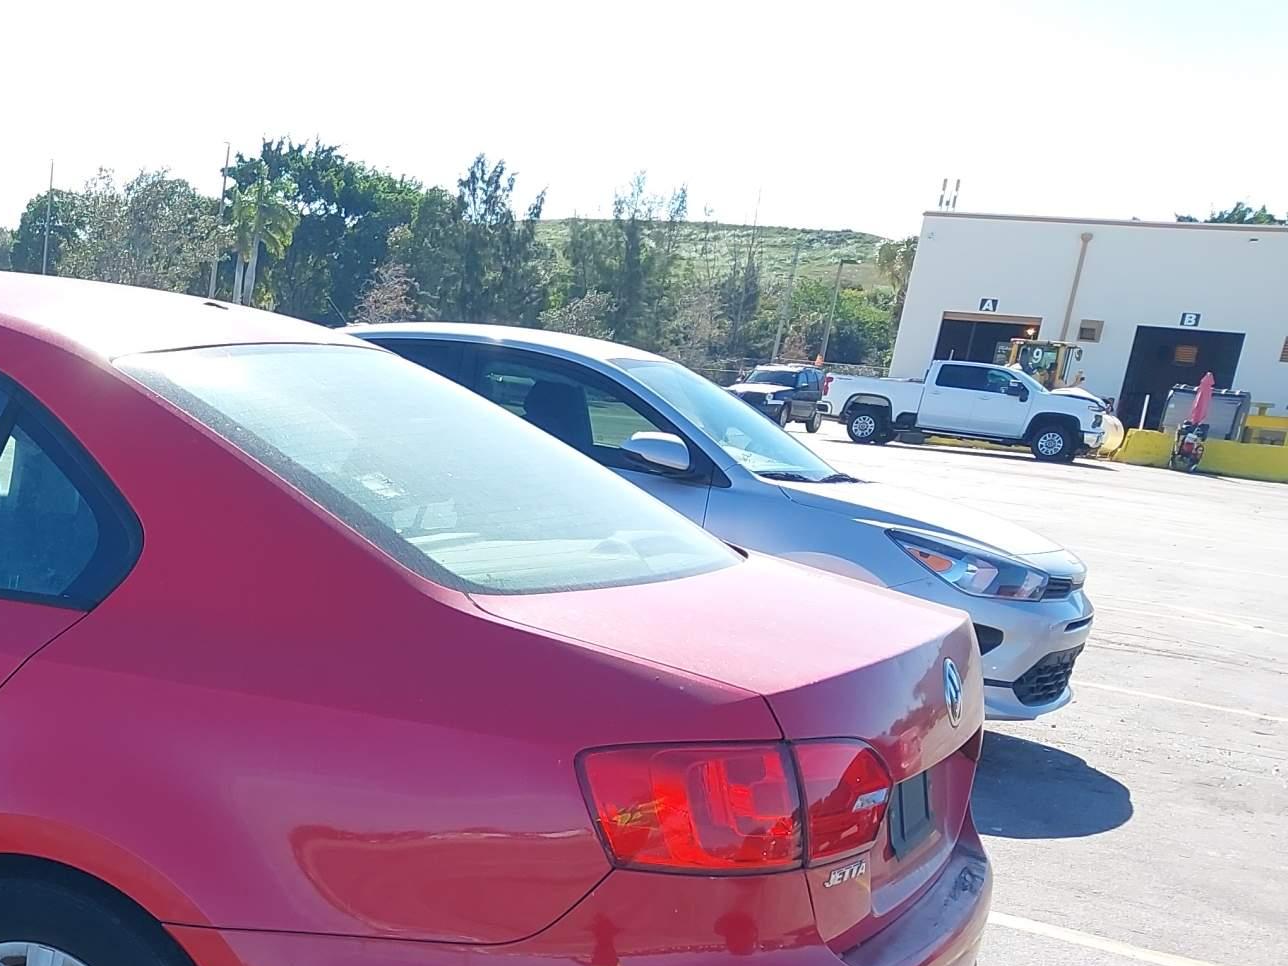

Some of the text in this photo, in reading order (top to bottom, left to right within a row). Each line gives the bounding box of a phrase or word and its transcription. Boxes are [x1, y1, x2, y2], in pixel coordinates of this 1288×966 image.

[981, 299, 994, 311] A
[1183, 313, 1197, 326] B
[1032, 348, 1043, 364] 9
[823, 861, 866, 888] JETTA
